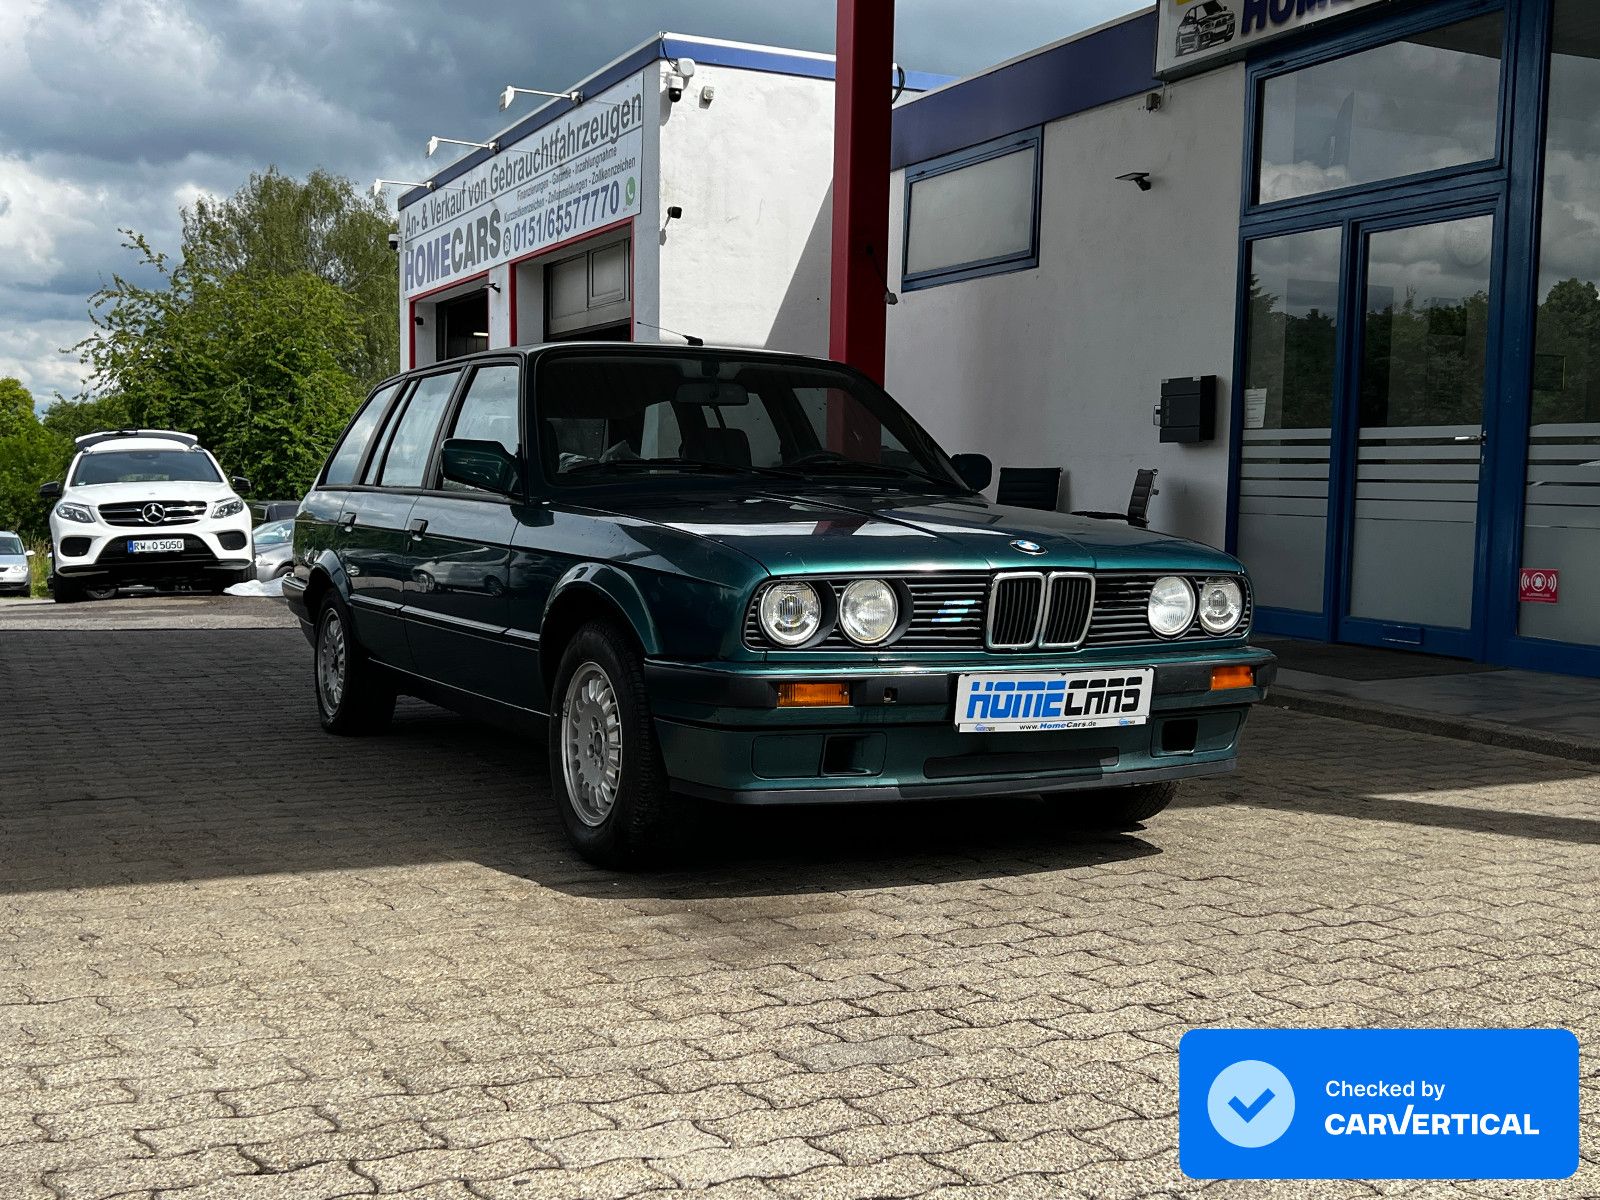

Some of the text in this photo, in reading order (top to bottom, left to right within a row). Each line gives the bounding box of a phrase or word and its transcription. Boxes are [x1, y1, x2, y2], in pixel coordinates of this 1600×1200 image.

[405, 93, 642, 239] An- & Verkauf von Gebrauchtfahrzeugen
[575, 146, 618, 174] Inzahlungnahme
[591, 157, 636, 186] Zollkennzeichen
[513, 180, 620, 252] 0151/65577770
[404, 208, 501, 292] HOMECARS
[134, 541, 146, 550] RW
[160, 540, 183, 550] 5050
[966, 676, 1143, 719] HOMECARS
[1019, 721, 1097, 731] www.HomeCars.de
